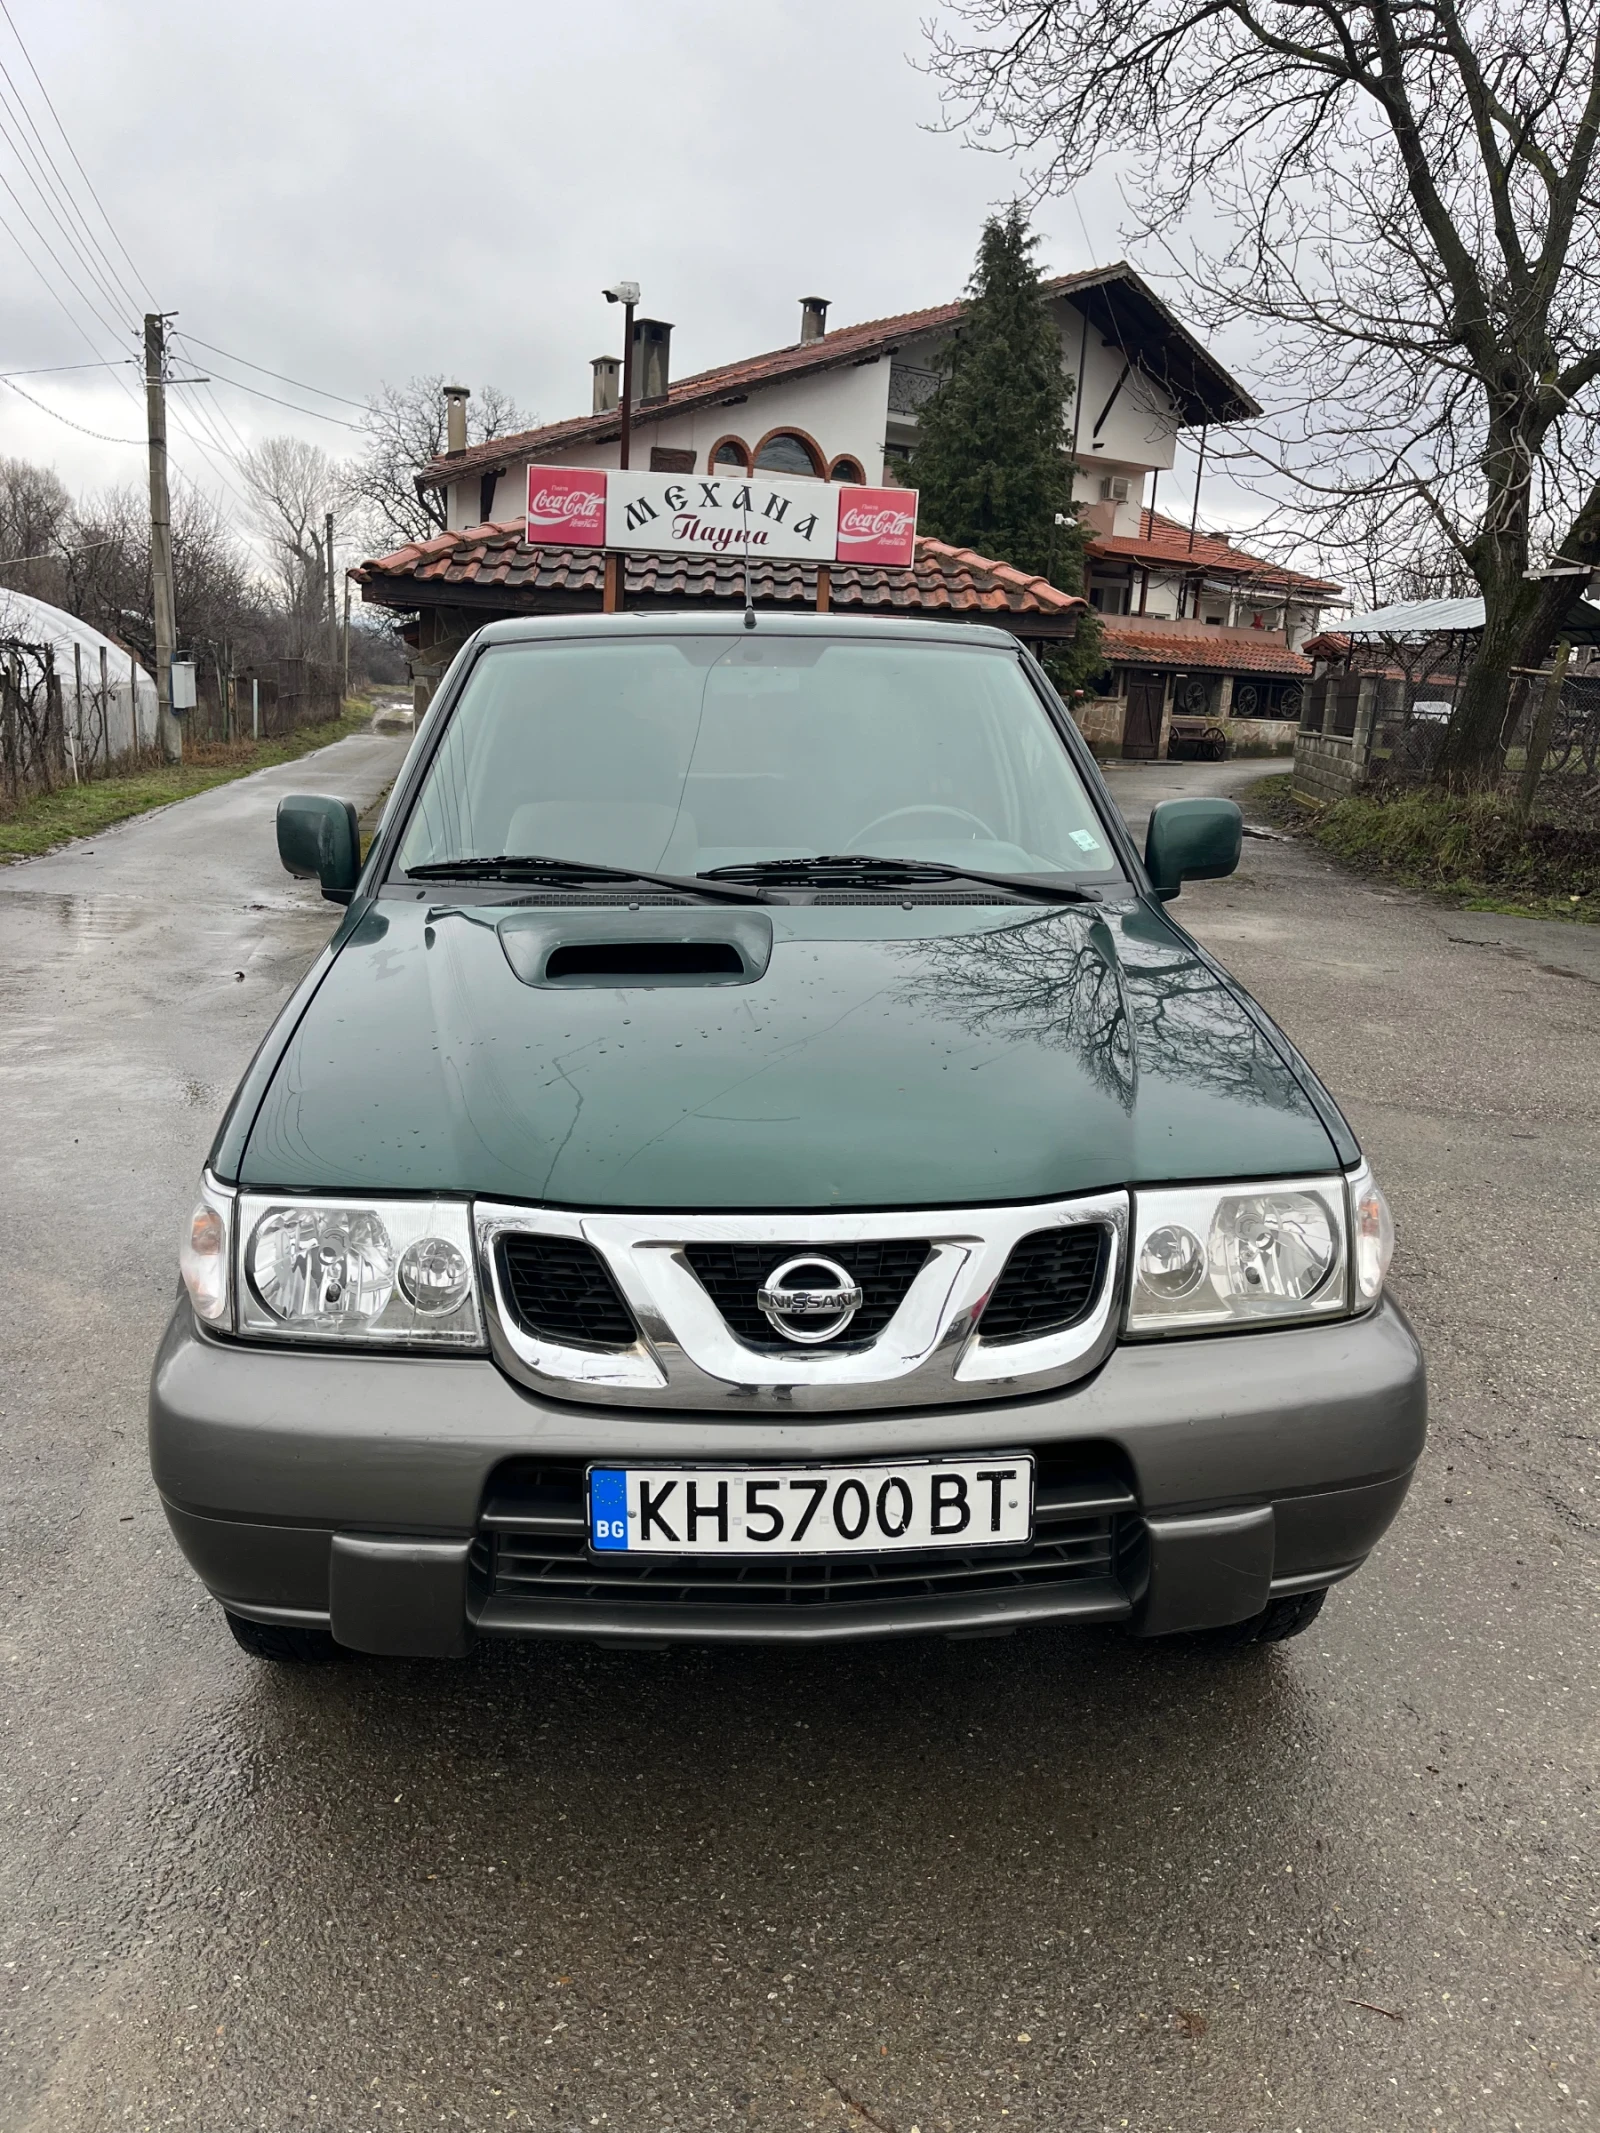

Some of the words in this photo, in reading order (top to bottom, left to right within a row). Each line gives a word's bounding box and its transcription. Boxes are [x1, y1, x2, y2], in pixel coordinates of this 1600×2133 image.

[531, 488, 601, 517] Coca-Cola
[671, 513, 770, 552] Пауна
[841, 507, 909, 536] Coca-Cola
[770, 1292, 852, 1310] NISSAN
[596, 1519, 625, 1539] BG
